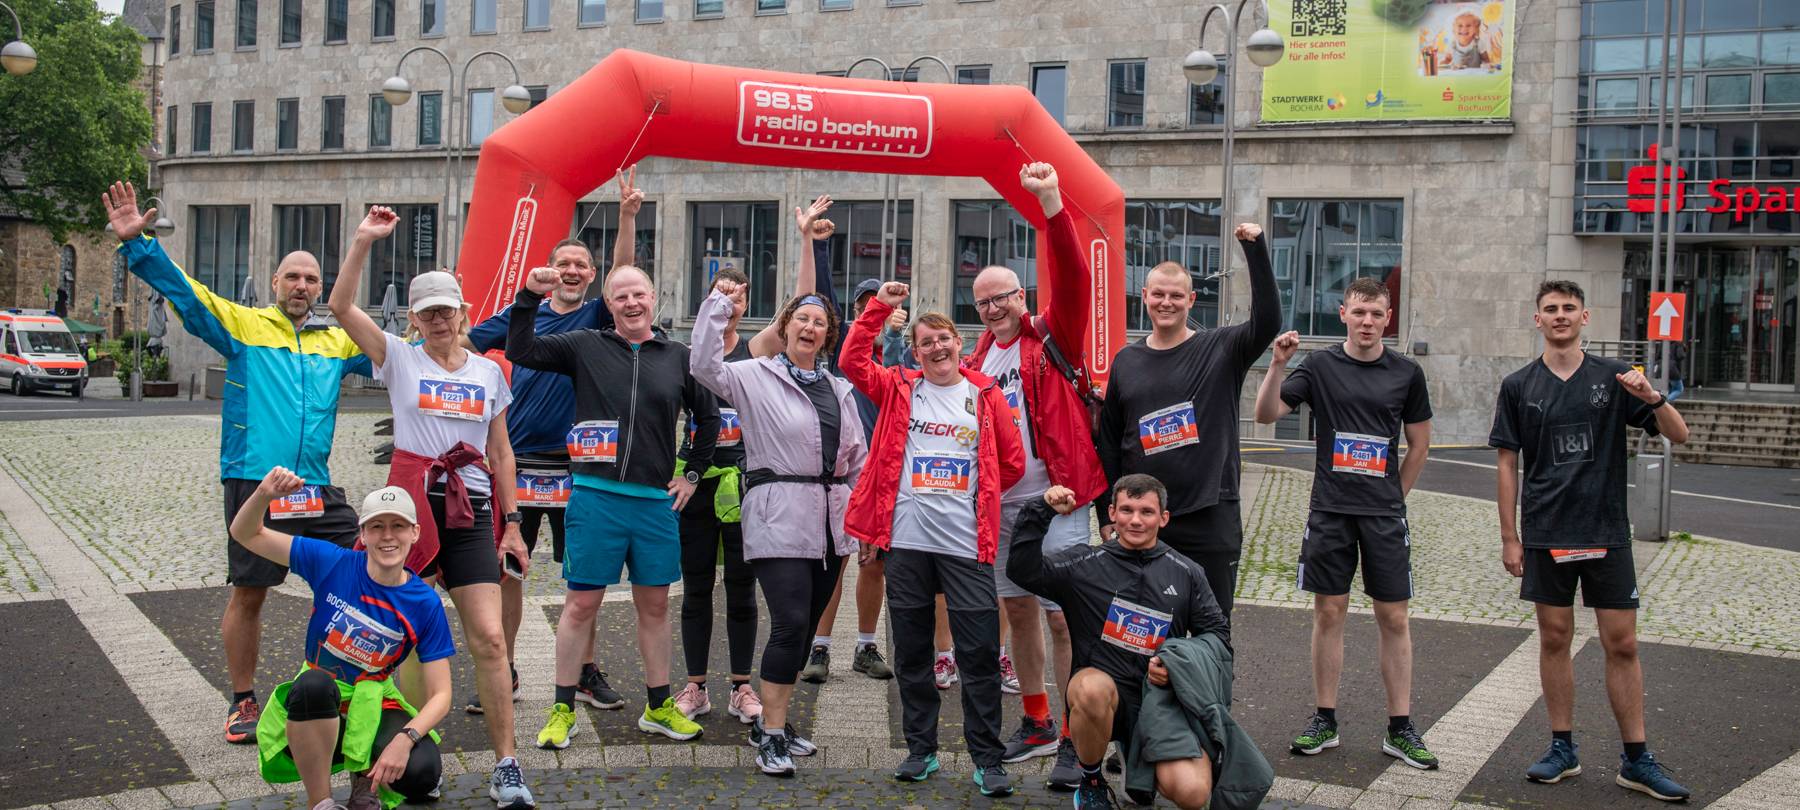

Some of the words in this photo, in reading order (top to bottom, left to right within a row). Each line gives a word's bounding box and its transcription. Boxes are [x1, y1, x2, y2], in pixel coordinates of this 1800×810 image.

[1289, 40, 1307, 49] Hier
[1310, 40, 1346, 49] scannen
[1289, 52, 1302, 61] für
[1303, 52, 1319, 61] alle
[753, 89, 814, 112] 98.5
[1271, 95, 1324, 104] STADTWERKE
[1458, 93, 1502, 103] Sparkasse
[1290, 104, 1324, 112] BOCHUM
[1458, 104, 1493, 112] Bochum
[754, 114, 818, 133] radio
[822, 117, 918, 139] bochum
[515, 231, 525, 252] beste
[513, 250, 521, 263] die
[443, 393, 463, 402] 1221
[442, 401, 462, 411] INGE
[1158, 432, 1184, 445] PIERRE
[1555, 432, 1589, 453] 1&1
[933, 470, 949, 478] 312
[924, 479, 956, 487] CLAUDIA
[290, 503, 307, 511] JENS
[1126, 624, 1148, 637] 2975
[1121, 633, 1147, 646] PETER
[344, 645, 373, 663] SARINA
